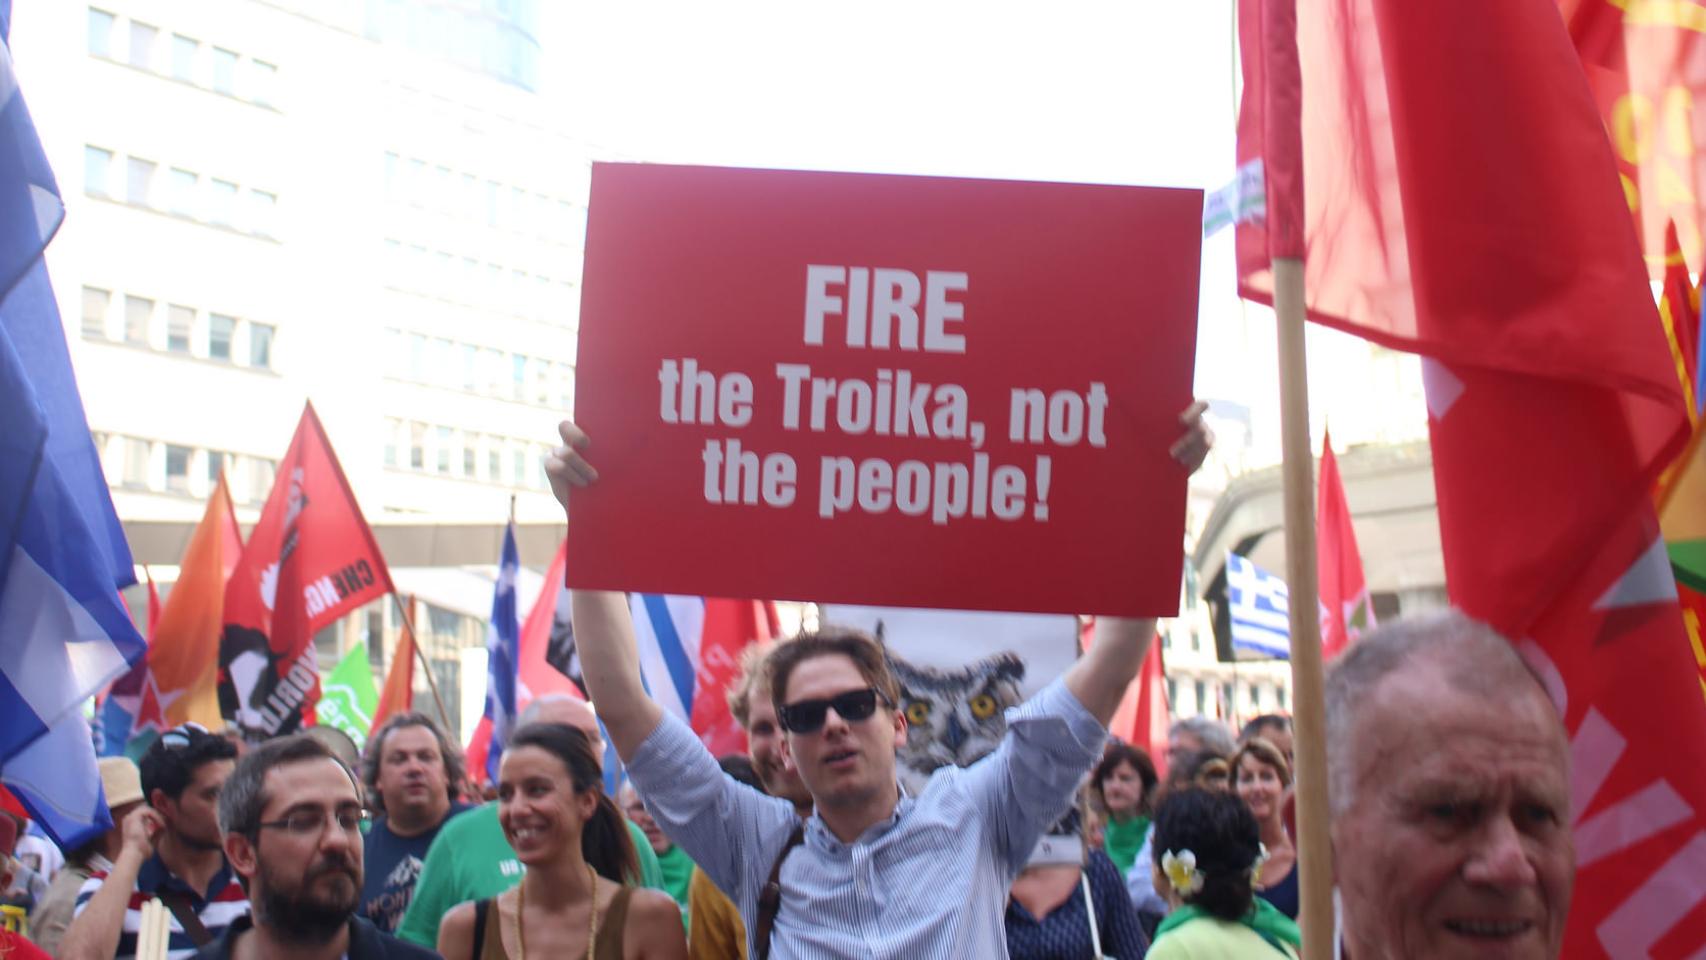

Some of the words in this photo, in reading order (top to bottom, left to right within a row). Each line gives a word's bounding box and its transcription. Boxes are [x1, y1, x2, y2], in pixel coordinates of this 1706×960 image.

[804, 264, 969, 353] FIRE
[658, 358, 754, 427] the
[776, 363, 985, 448] Troika,
[1009, 382, 1109, 447] not
[702, 439, 797, 507] the
[819, 453, 1051, 524] people!
